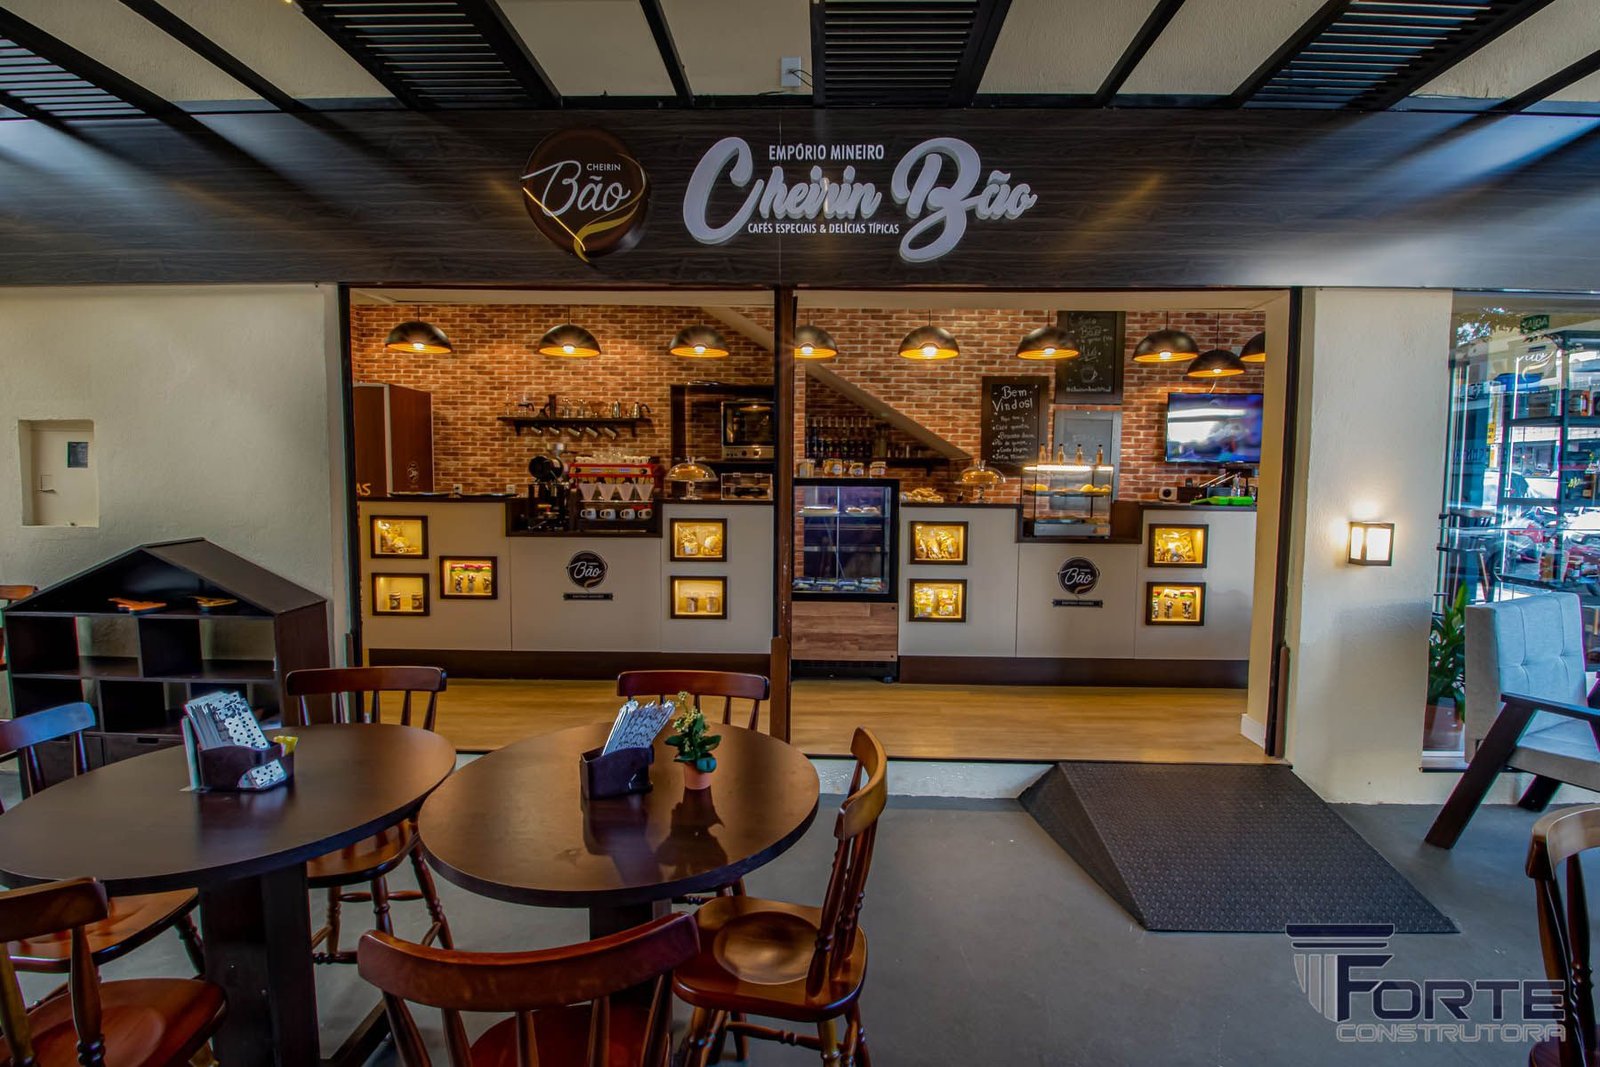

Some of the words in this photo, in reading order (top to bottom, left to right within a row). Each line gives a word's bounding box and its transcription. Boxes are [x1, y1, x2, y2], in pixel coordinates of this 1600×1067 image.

[769, 143, 826, 160] EMPÓRIO
[830, 144, 884, 160] MINEIRO
[586, 163, 621, 172] CHEIRIN
[521, 160, 631, 227] Bão
[683, 136, 882, 245] Cheirin
[891, 137, 1038, 263] Bão
[748, 223, 773, 234] CAFÉS
[775, 223, 817, 234] ESPECIAIS
[819, 224, 827, 234] &
[829, 222, 866, 234] DELÍCIAS
[868, 222, 900, 235] TÍPICAS
[1001, 386, 1027, 399] Bem
[568, 561, 602, 579] Bão
[1060, 567, 1094, 585] Bão
